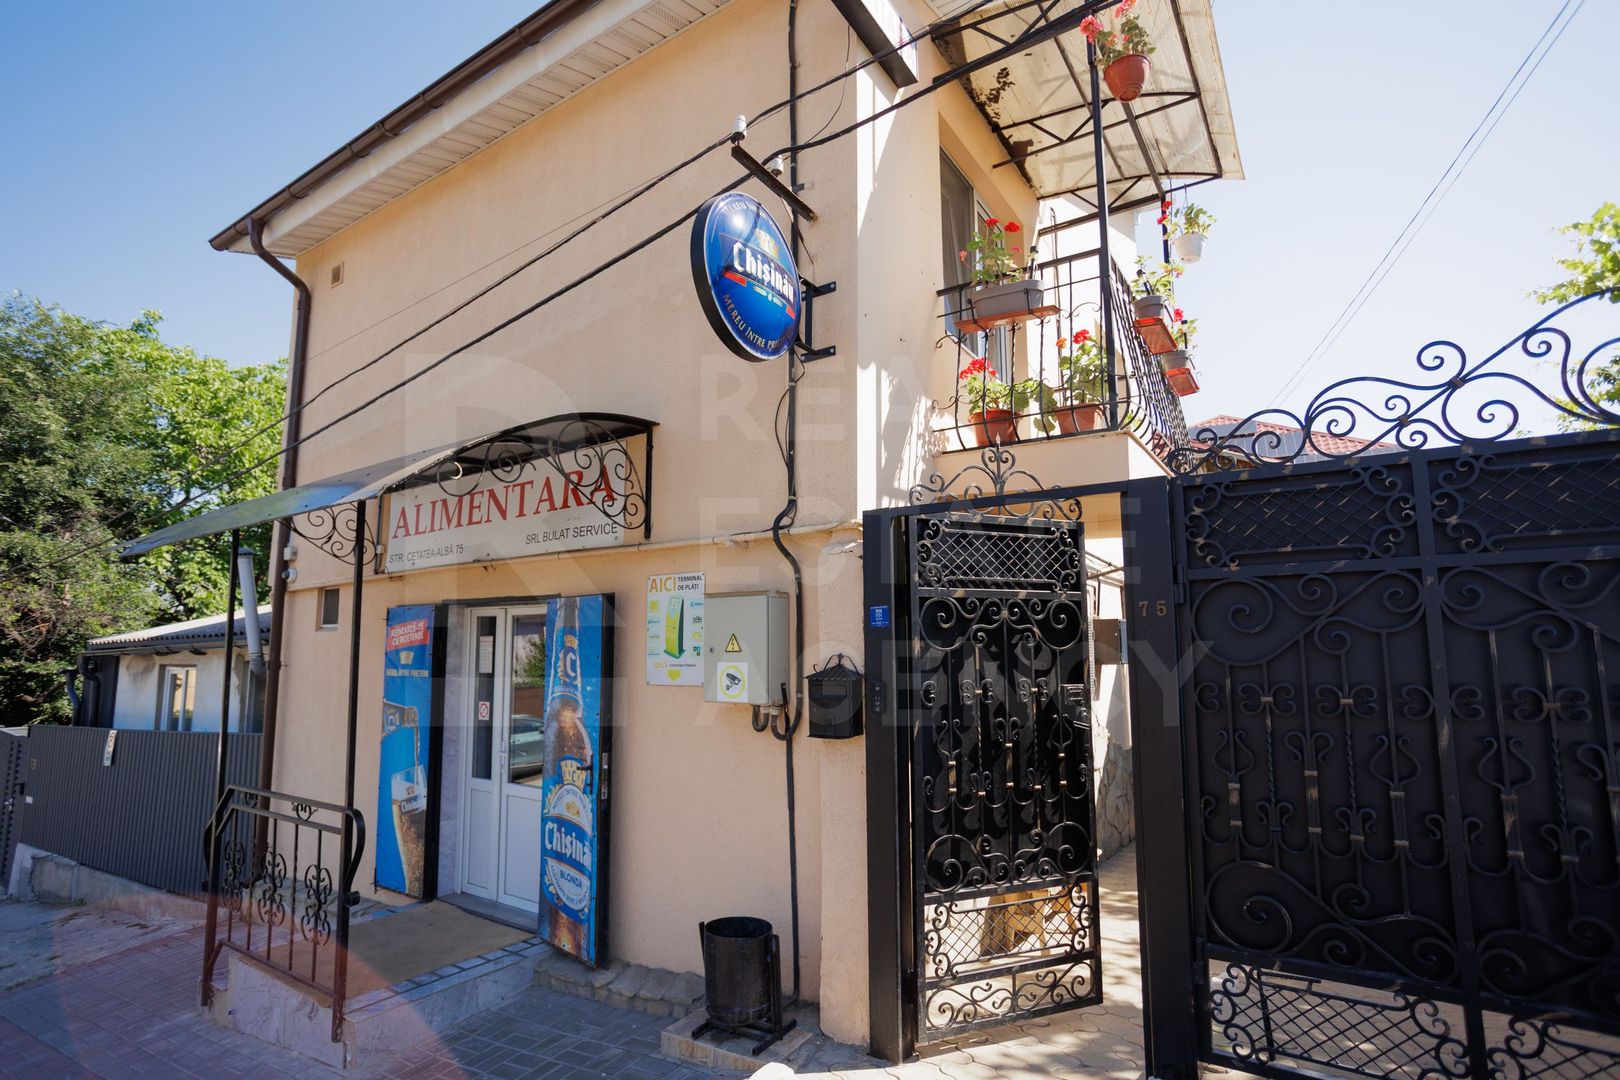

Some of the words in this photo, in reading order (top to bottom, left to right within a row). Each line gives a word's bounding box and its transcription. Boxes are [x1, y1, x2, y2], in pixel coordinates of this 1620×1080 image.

[723, 294, 746, 330] MEREU
[392, 463, 618, 539] ALIMENTARA
[525, 533, 540, 545] SRL
[543, 527, 570, 543] BULAT
[572, 522, 618, 538] SERVICE
[455, 544, 464, 554] 75
[650, 575, 677, 593] AICI
[678, 574, 703, 583] TERMINAL
